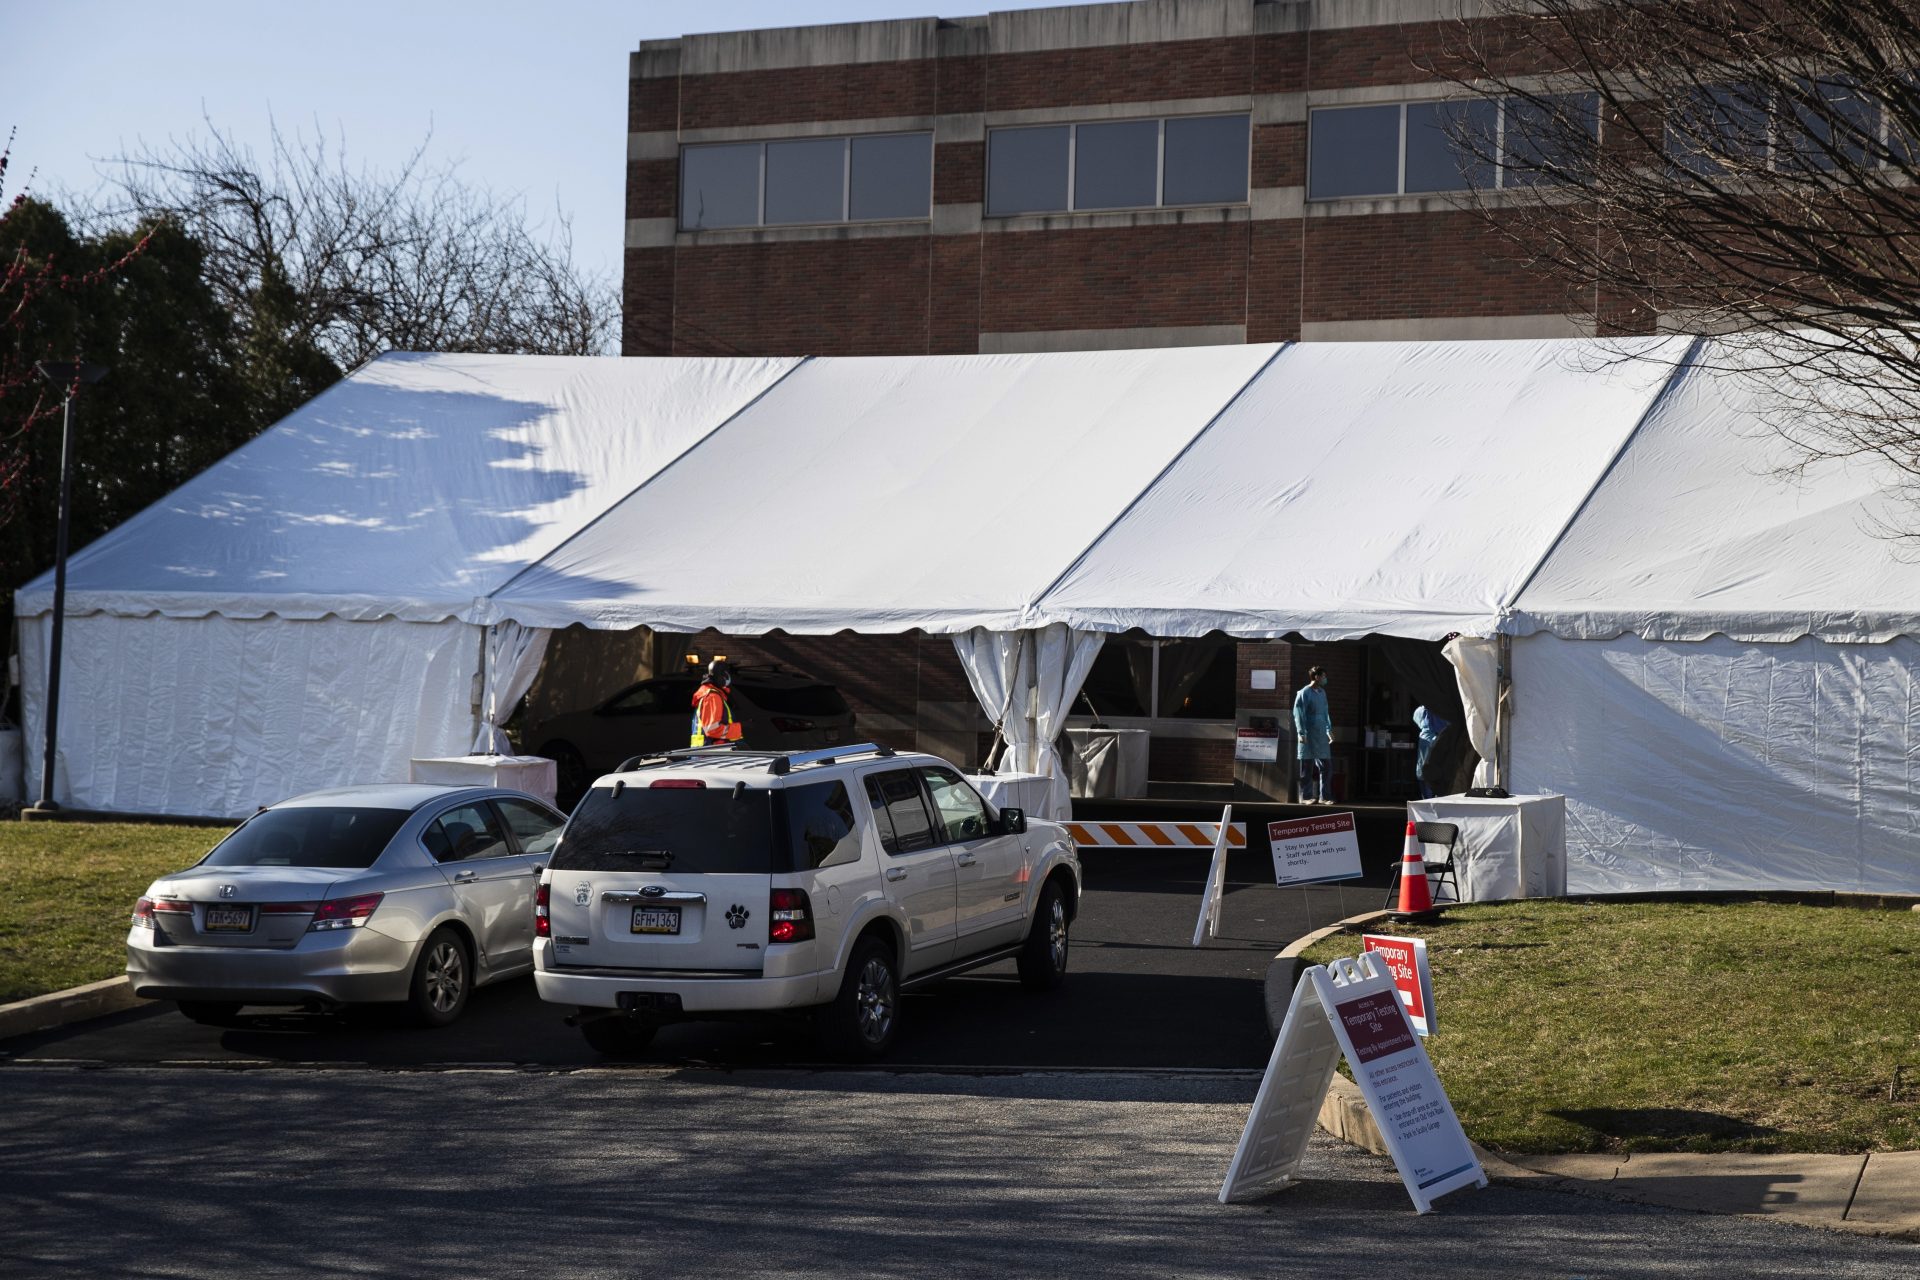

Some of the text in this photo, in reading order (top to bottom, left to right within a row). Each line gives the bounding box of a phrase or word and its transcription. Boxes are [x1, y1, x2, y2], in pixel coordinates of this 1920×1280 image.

[1272, 819, 1351, 836] Temporary Testing Site
[1305, 841, 1318, 849] your
[1286, 851, 1300, 859] Staff
[1336, 846, 1347, 854] you
[1370, 942, 1408, 964] Temporary
[1397, 963, 1413, 980] Site
[1344, 1005, 1398, 1026] Temporary Testing
[1370, 1023, 1383, 1032] Site
[1356, 1046, 1374, 1056] Testing
[1378, 1037, 1402, 1049] Appointment
[1400, 1033, 1412, 1042] Only
[1397, 1059, 1415, 1069] restricted
[1386, 1090, 1403, 1102] patients
[1384, 1100, 1401, 1111] entering
[1399, 1118, 1416, 1129] entrance
